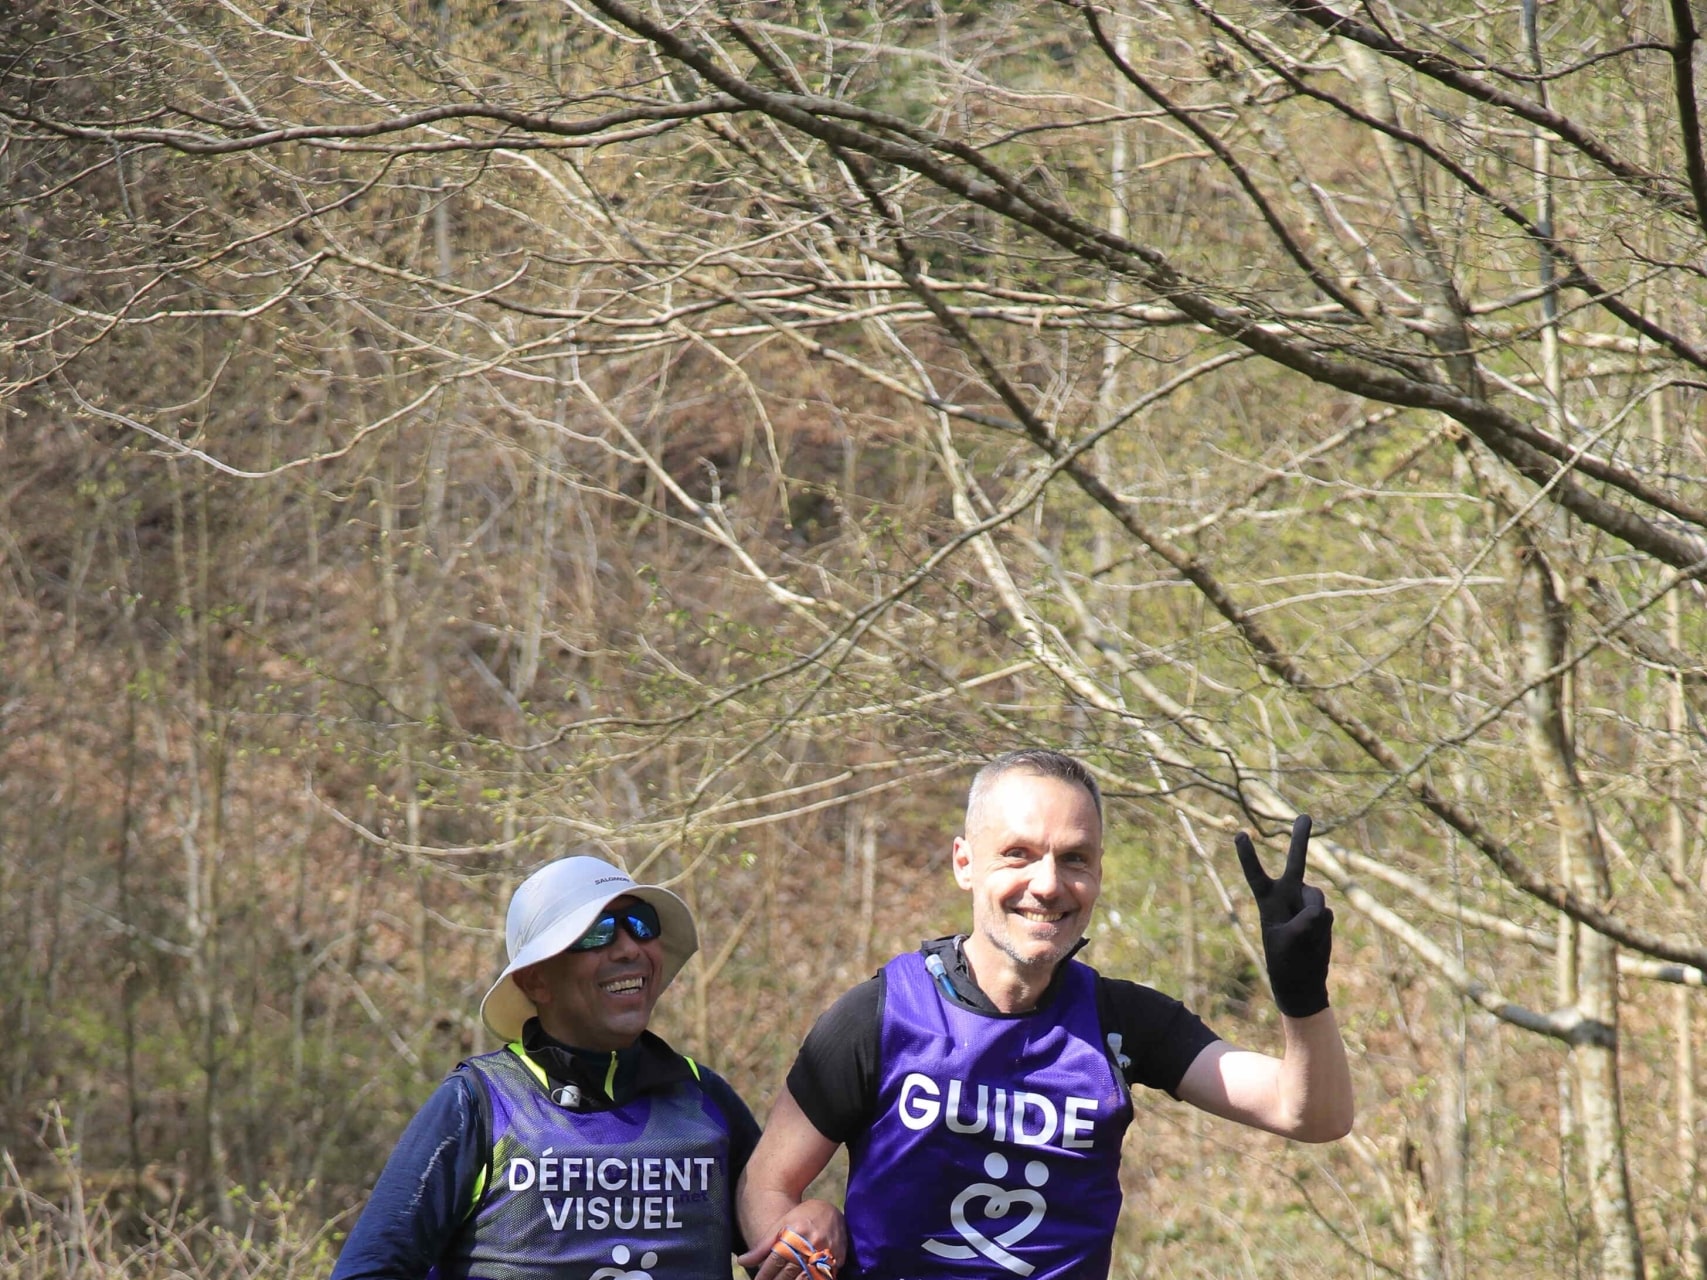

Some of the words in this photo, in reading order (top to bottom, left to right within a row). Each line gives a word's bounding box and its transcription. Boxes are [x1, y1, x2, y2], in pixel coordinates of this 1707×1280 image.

[899, 1073, 1099, 1148] GUIDE
[508, 1147, 715, 1192] DÉFICIENT
[543, 1197, 683, 1231] VISUEL
